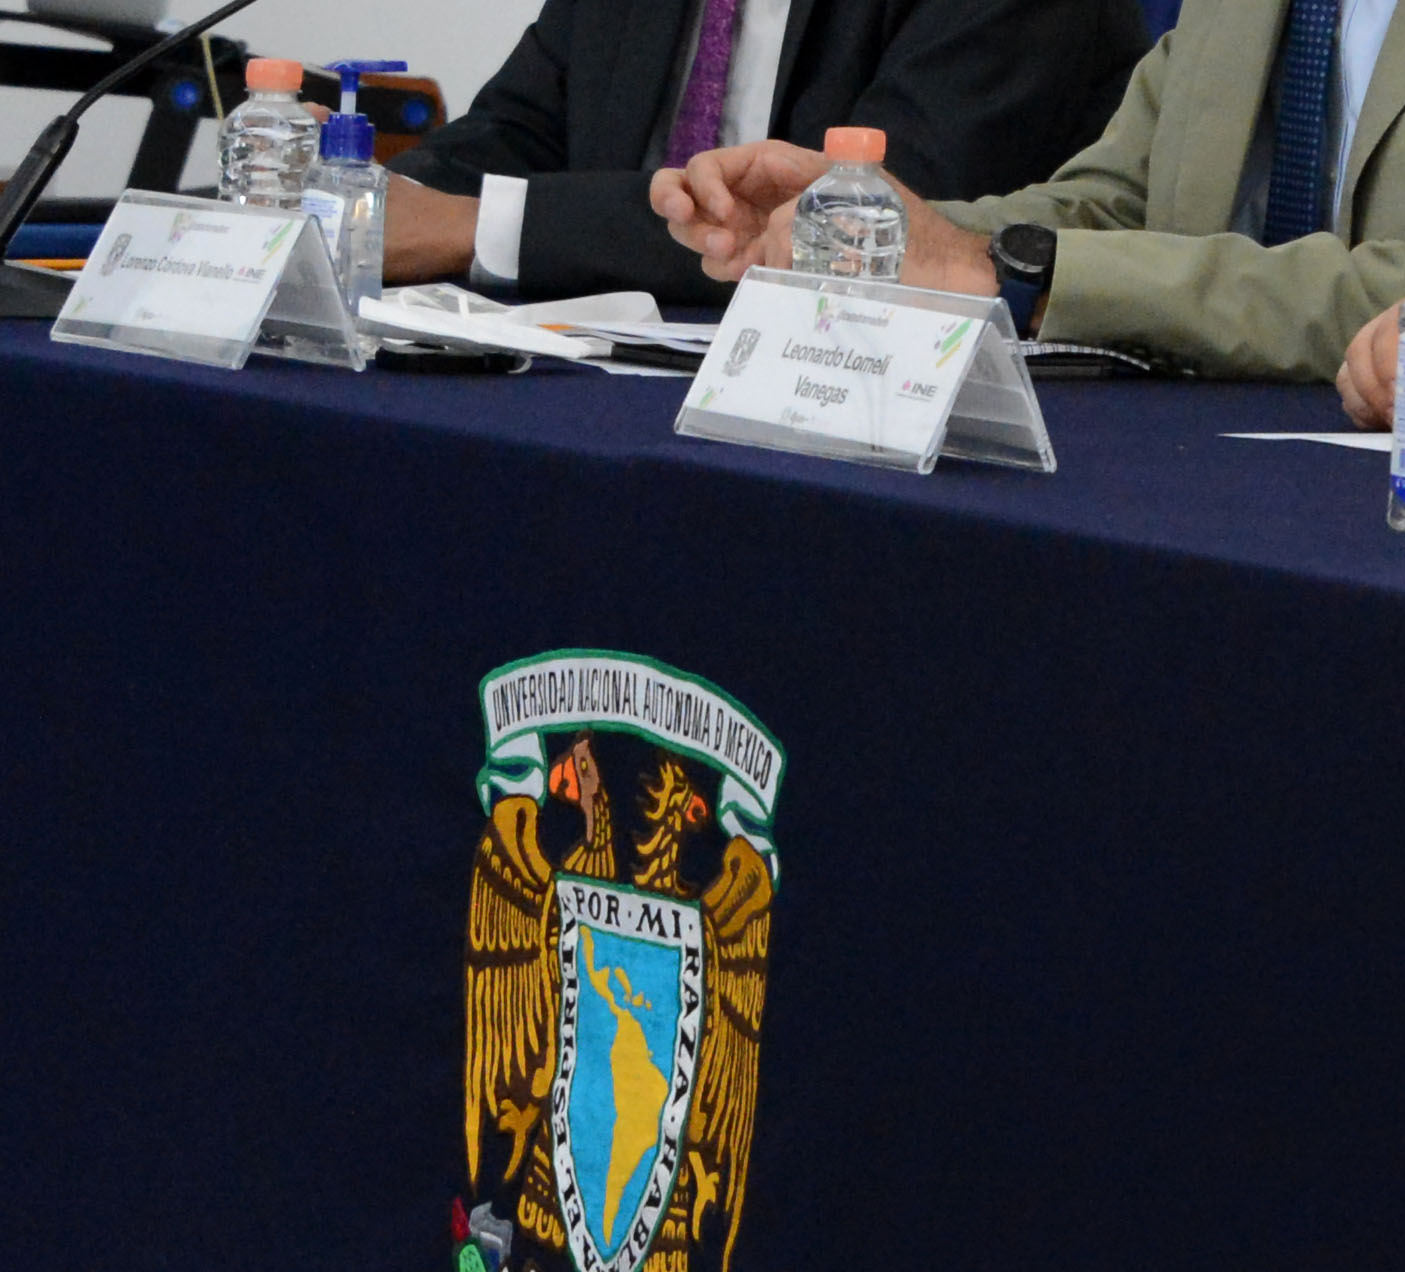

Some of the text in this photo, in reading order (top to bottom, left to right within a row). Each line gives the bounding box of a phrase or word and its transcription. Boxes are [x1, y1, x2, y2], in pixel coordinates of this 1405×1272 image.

[782, 338, 844, 368] Leonardo
[793, 374, 849, 407] Vanegas
[911, 382, 938, 399] INE
[492, 669, 574, 732] UNIVERSIDAD
[578, 668, 639, 717] NACIONAL
[642, 678, 711, 743] AUTONOMA
[723, 715, 774, 791] MEXICO
[572, 886, 621, 928] POR
[635, 902, 683, 940] MI
[672, 943, 700, 1107] RAZA
[557, 1168, 582, 1234] EL
